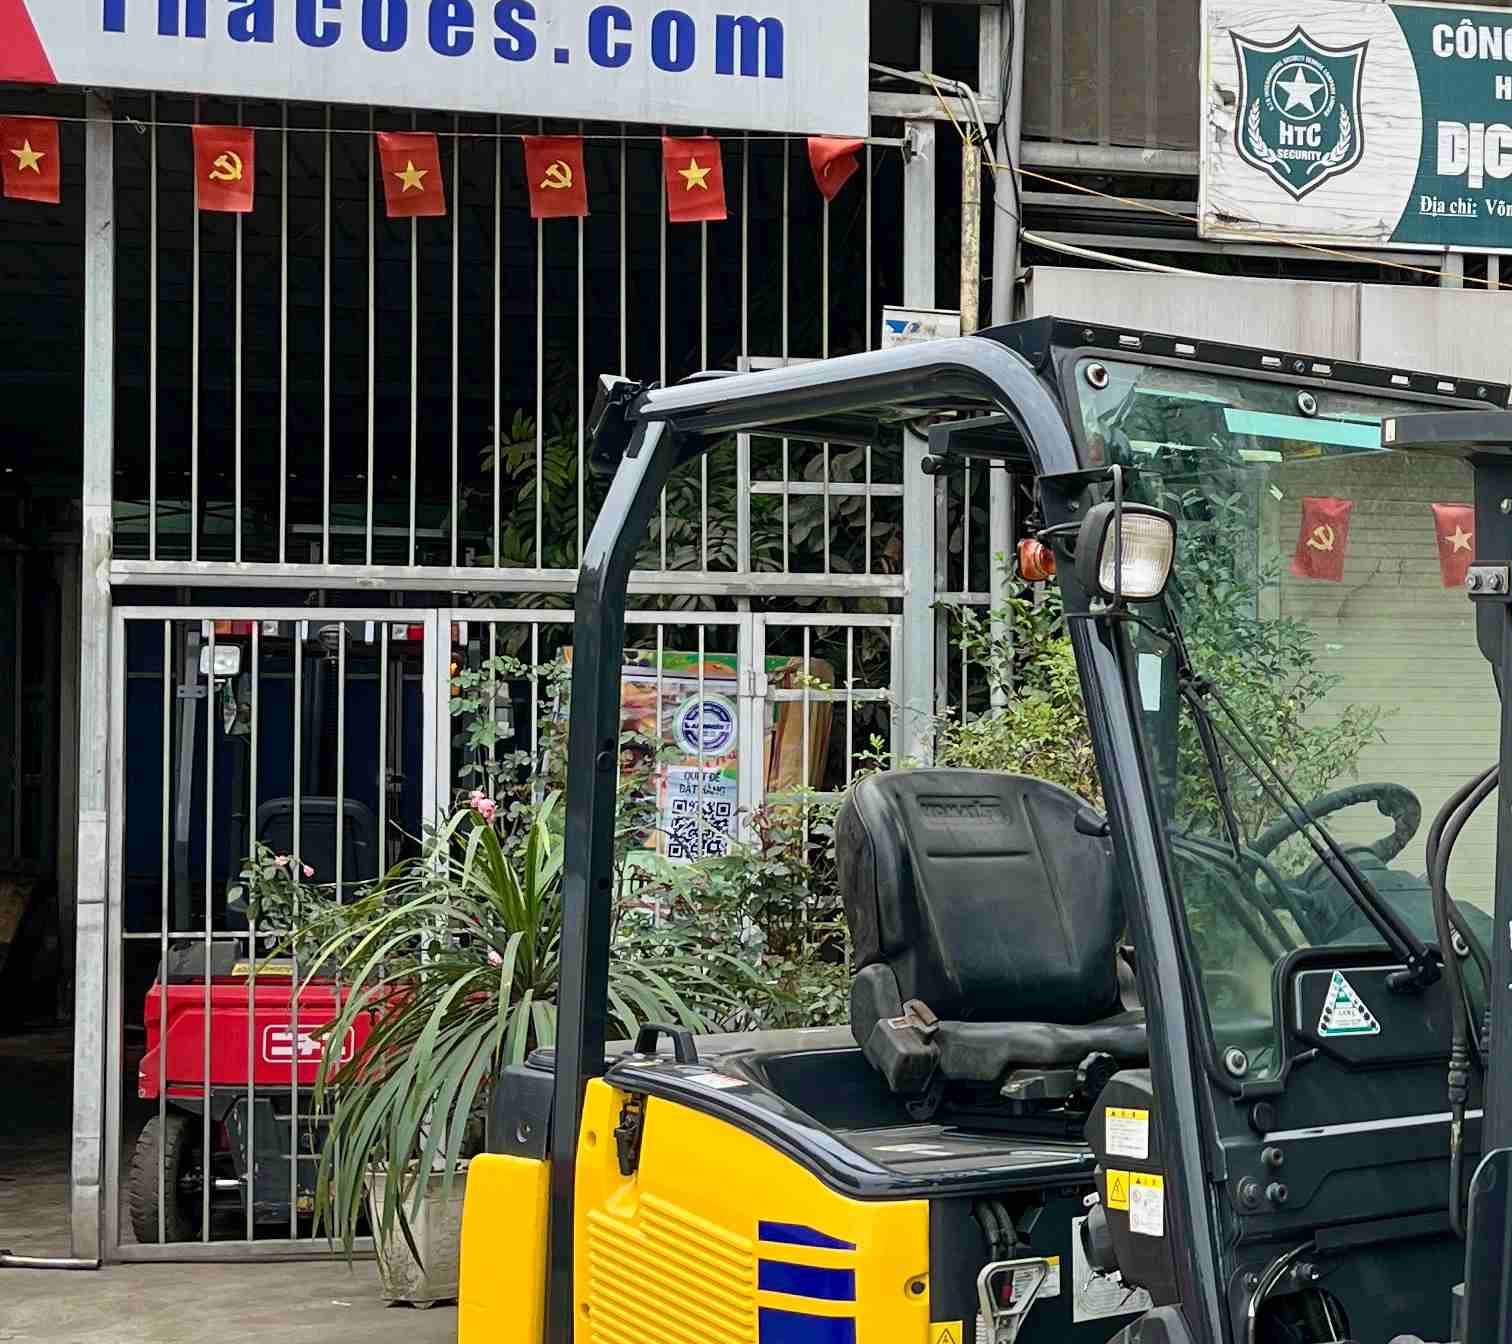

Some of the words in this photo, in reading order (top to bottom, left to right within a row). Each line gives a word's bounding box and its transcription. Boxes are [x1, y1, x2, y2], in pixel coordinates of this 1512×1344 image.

[1280, 120, 1322, 147] HTC
[1276, 149, 1322, 161] SECURITY
[1419, 195, 1446, 217] Địa
